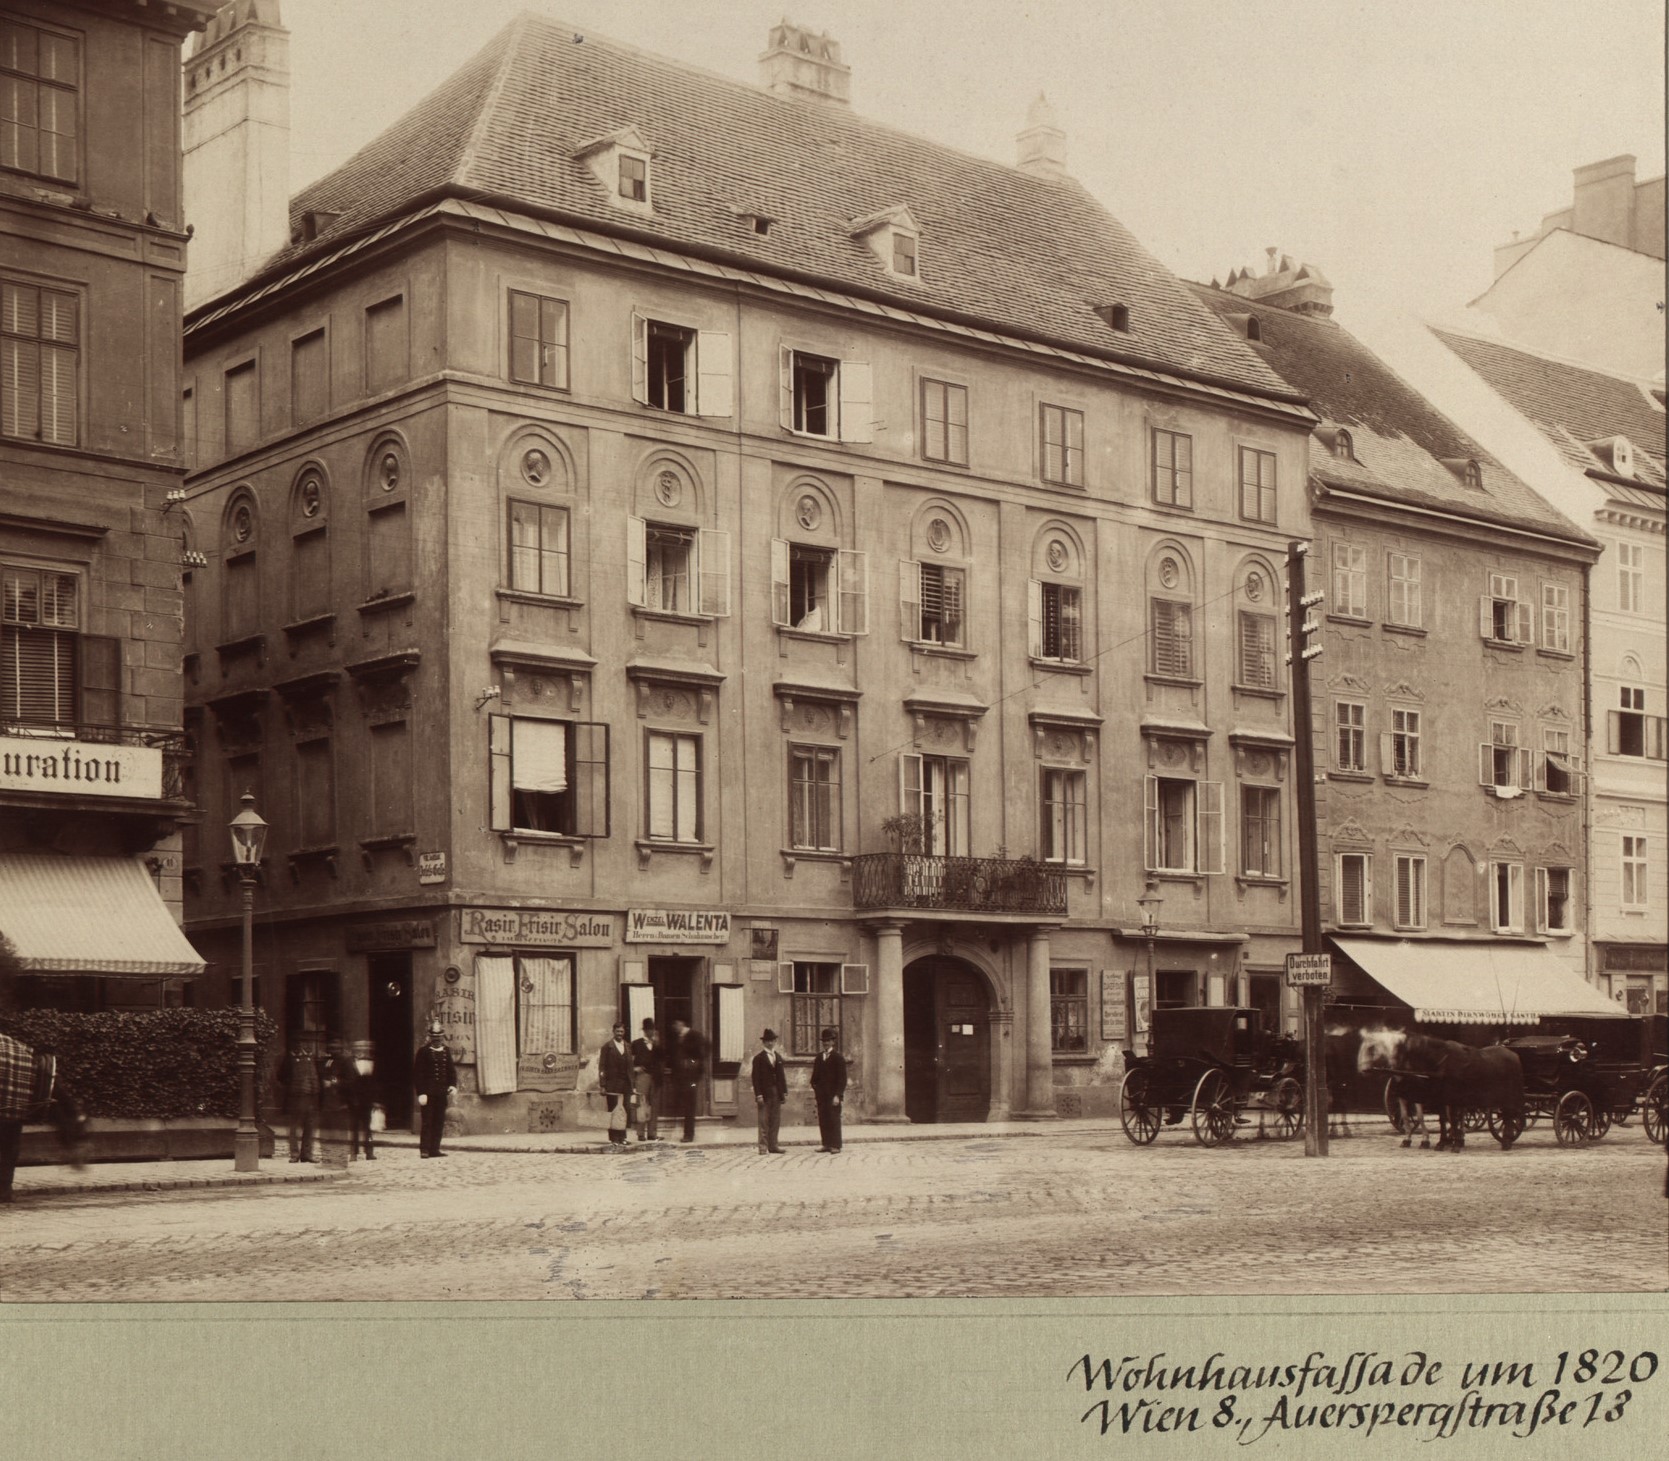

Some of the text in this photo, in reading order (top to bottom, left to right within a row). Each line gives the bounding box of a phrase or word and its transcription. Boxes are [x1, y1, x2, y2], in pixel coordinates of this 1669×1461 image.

[3, 746, 121, 784] uration
[562, 913, 611, 941] Salon
[666, 913, 729, 931] WALENTA
[1289, 955, 1329, 969] Durchfahrt
